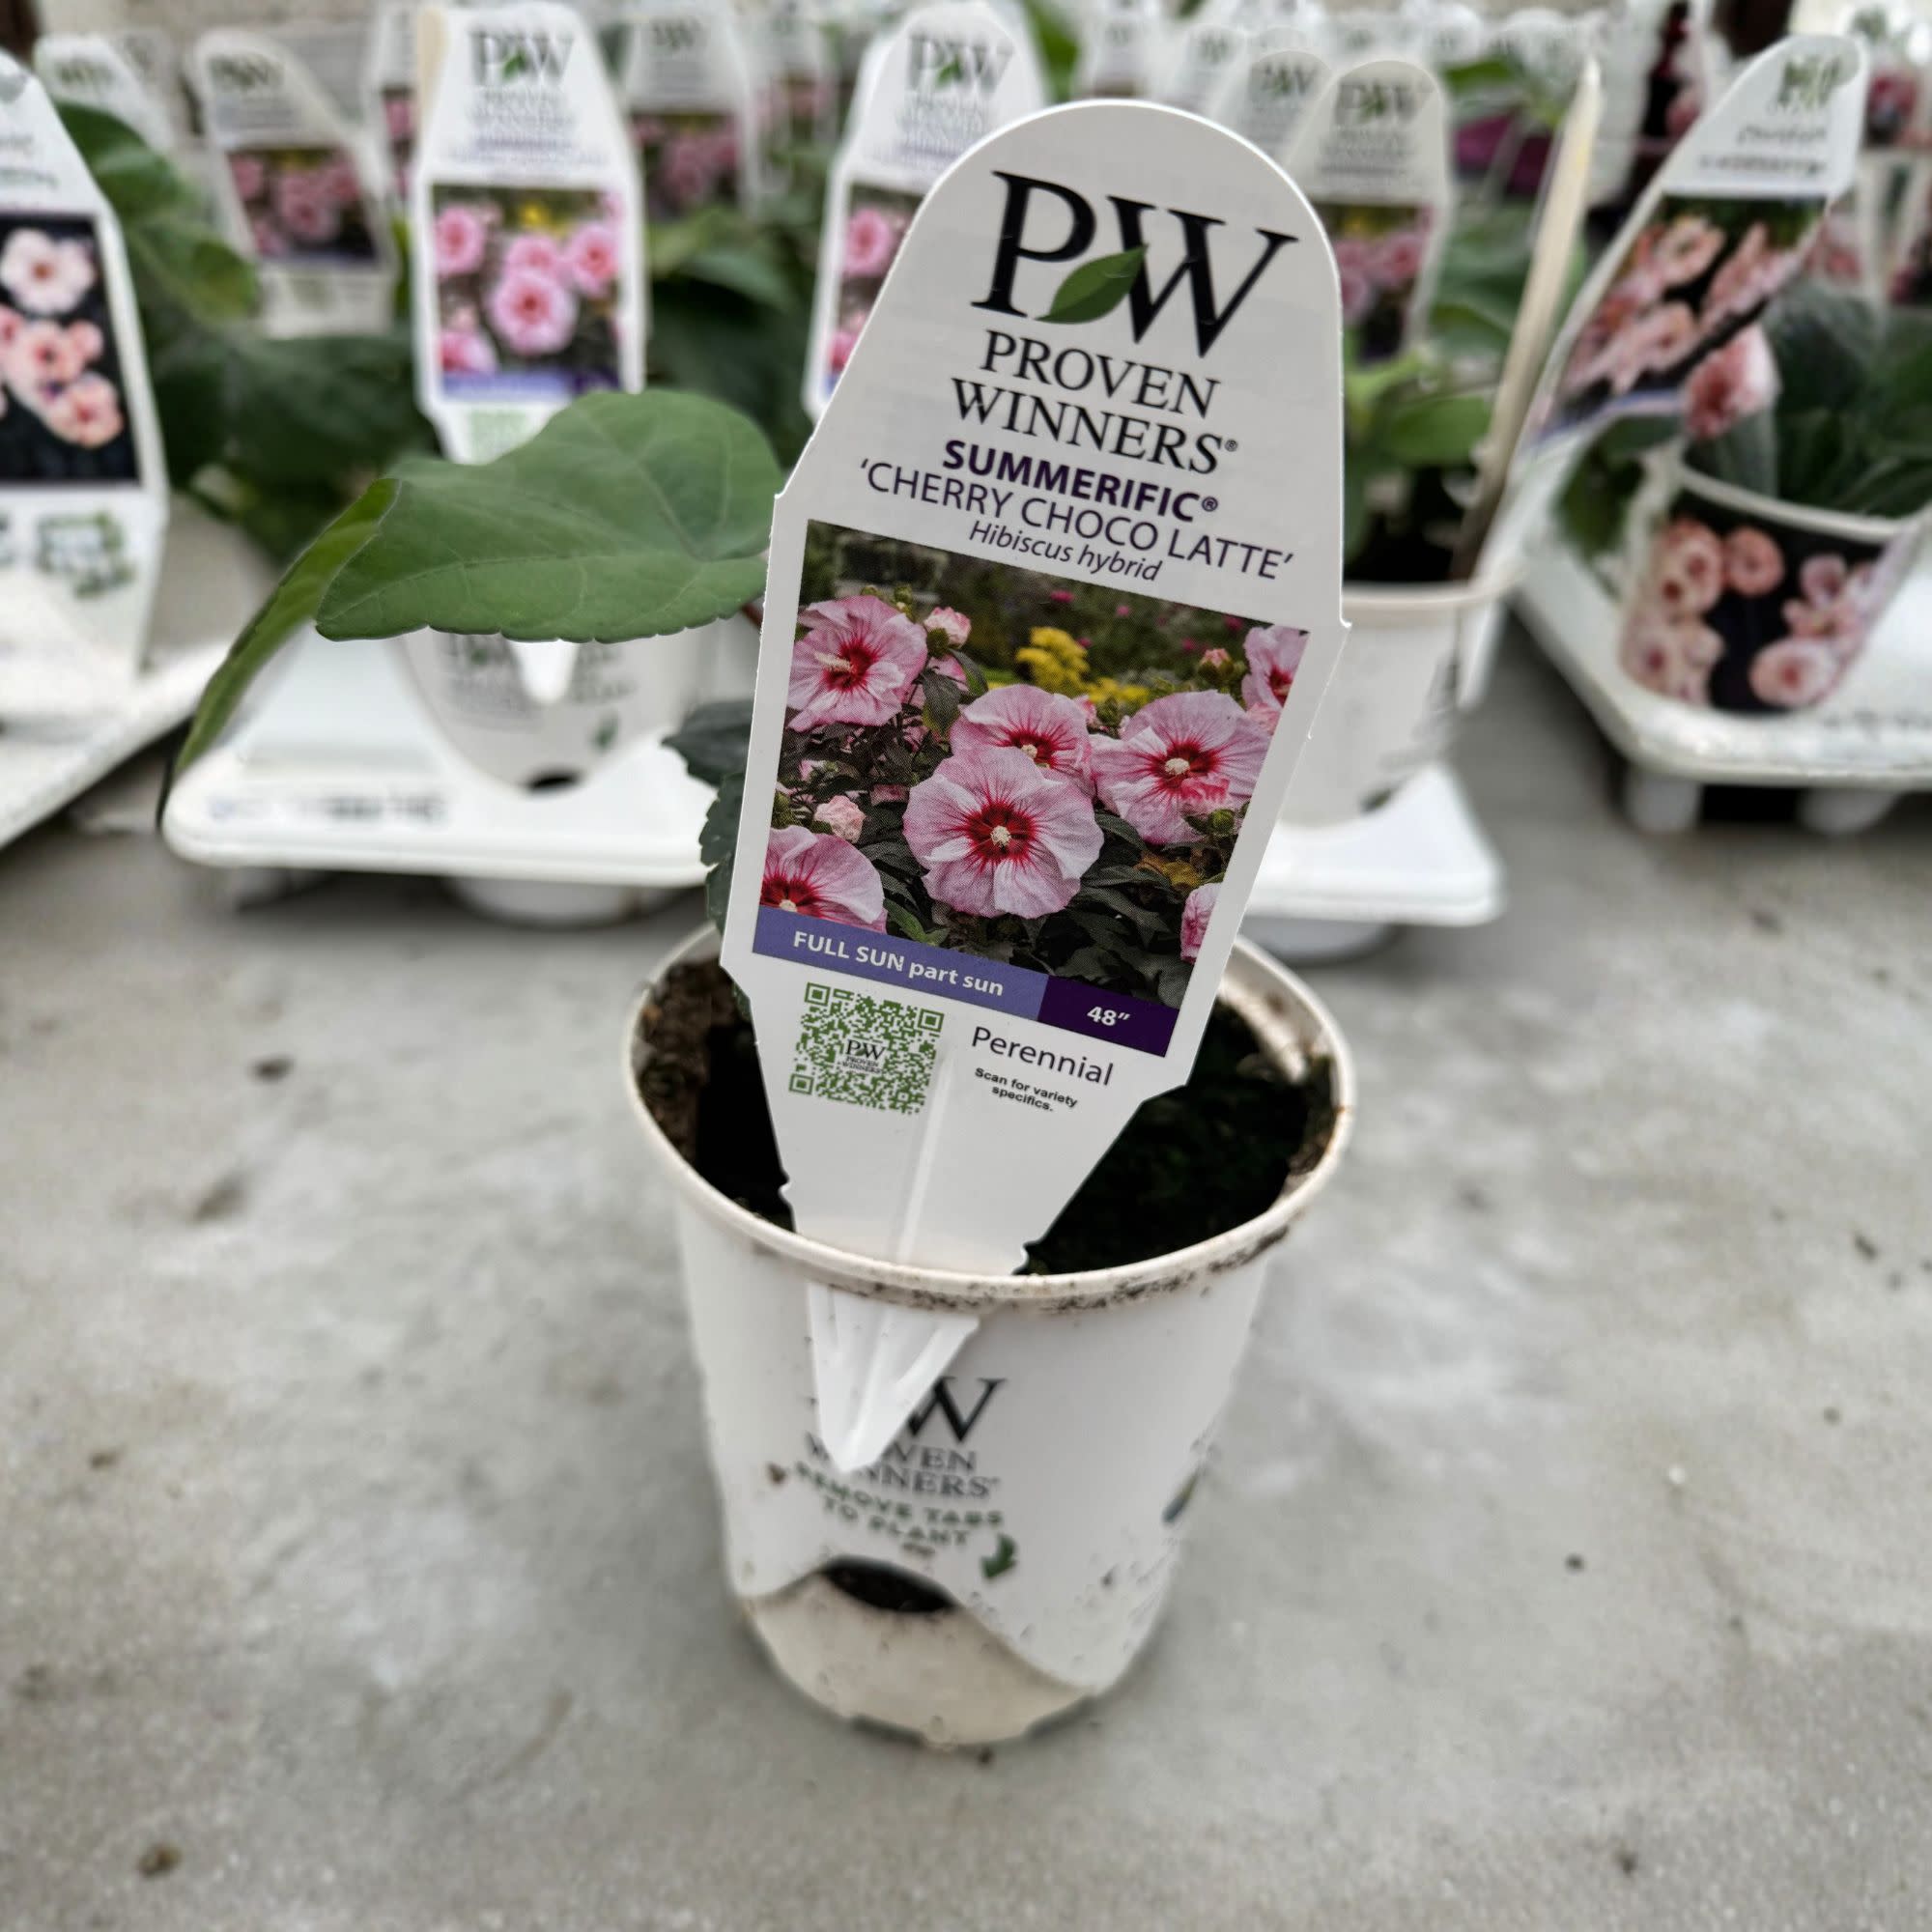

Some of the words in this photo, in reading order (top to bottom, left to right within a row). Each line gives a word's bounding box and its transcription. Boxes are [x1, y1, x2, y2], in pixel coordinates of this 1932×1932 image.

[971, 170, 1300, 358] PW
[980, 328, 1221, 418] PROVEN
[860, 458, 1013, 519] ‘CHERRY
[1021, 497, 1159, 552] CHOCO
[1167, 528, 1293, 580] LATTE’
[969, 520, 1073, 563] Hibiscus
[1077, 543, 1163, 582] hybrid
[793, 930, 850, 959] FULL
[855, 946, 905, 972] SUN
[908, 962, 959, 984] part
[962, 975, 1005, 996] sun
[846, 1038, 886, 1061] PW
[971, 1026, 1114, 1087] Perennial
[975, 1066, 1008, 1085] Scan
[1010, 1078, 1031, 1092] for
[1033, 1087, 1078, 1108] variety
[991, 1086, 1054, 1112] specifics.
